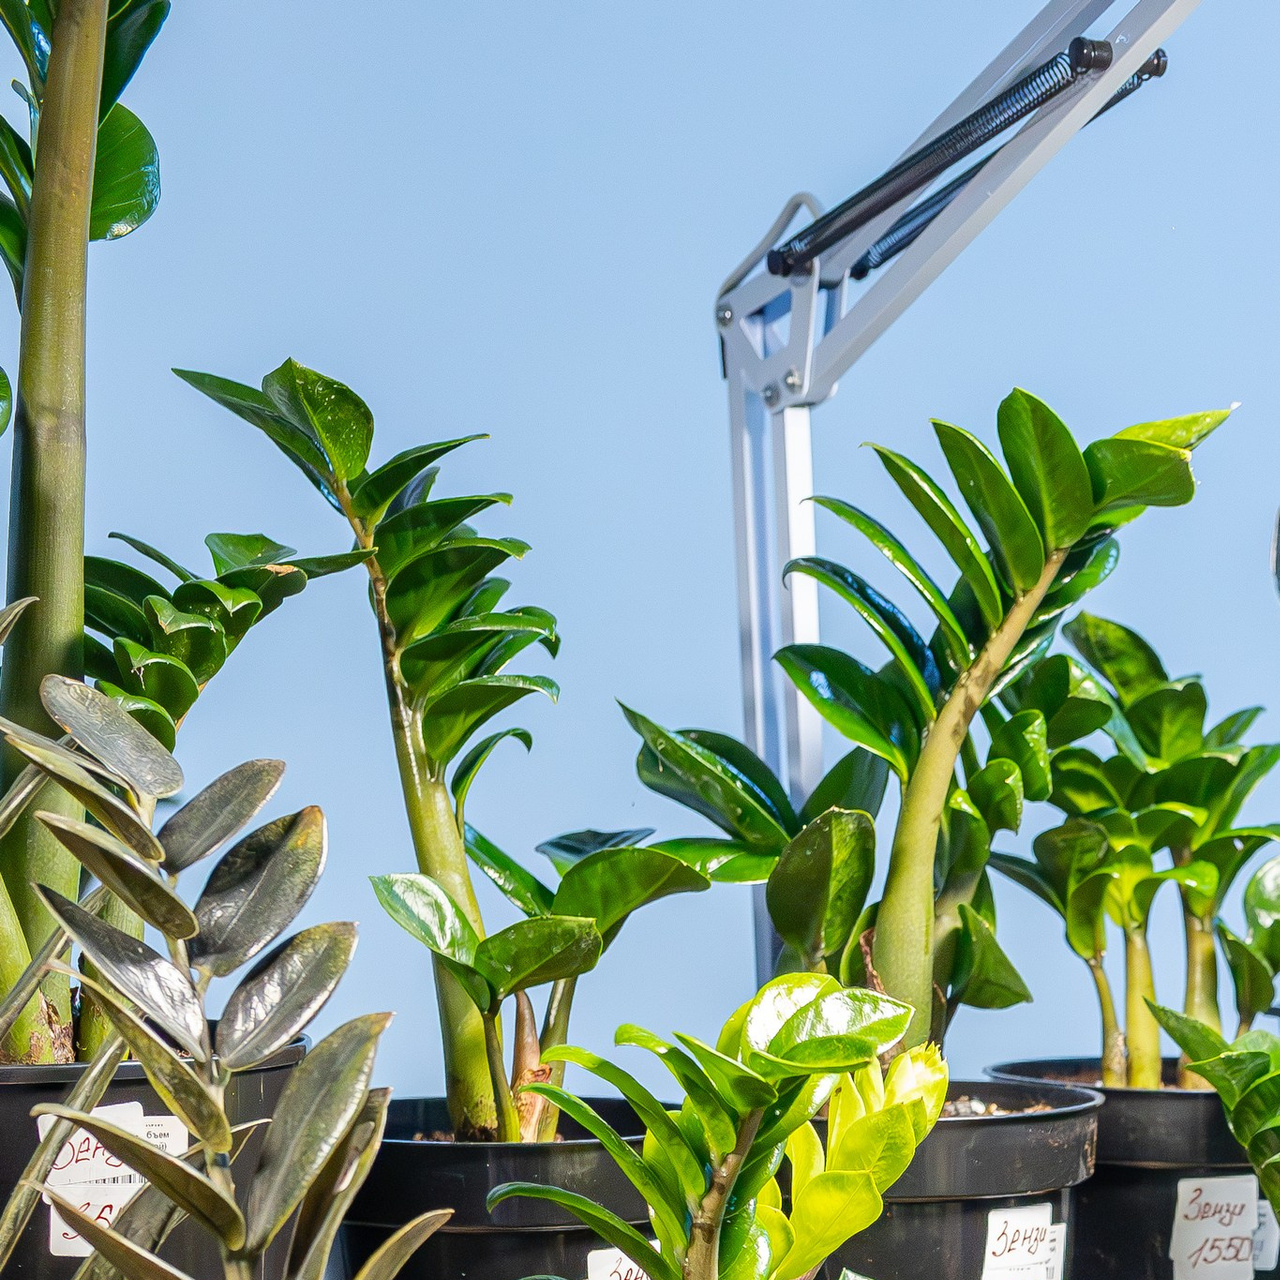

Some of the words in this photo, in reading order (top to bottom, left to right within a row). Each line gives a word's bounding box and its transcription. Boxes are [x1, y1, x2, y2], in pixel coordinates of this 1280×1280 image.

[1184, 1187, 1245, 1227] Зензи
[991, 1220, 1047, 1257] Зензи
[1187, 1236, 1254, 1269] 1550
